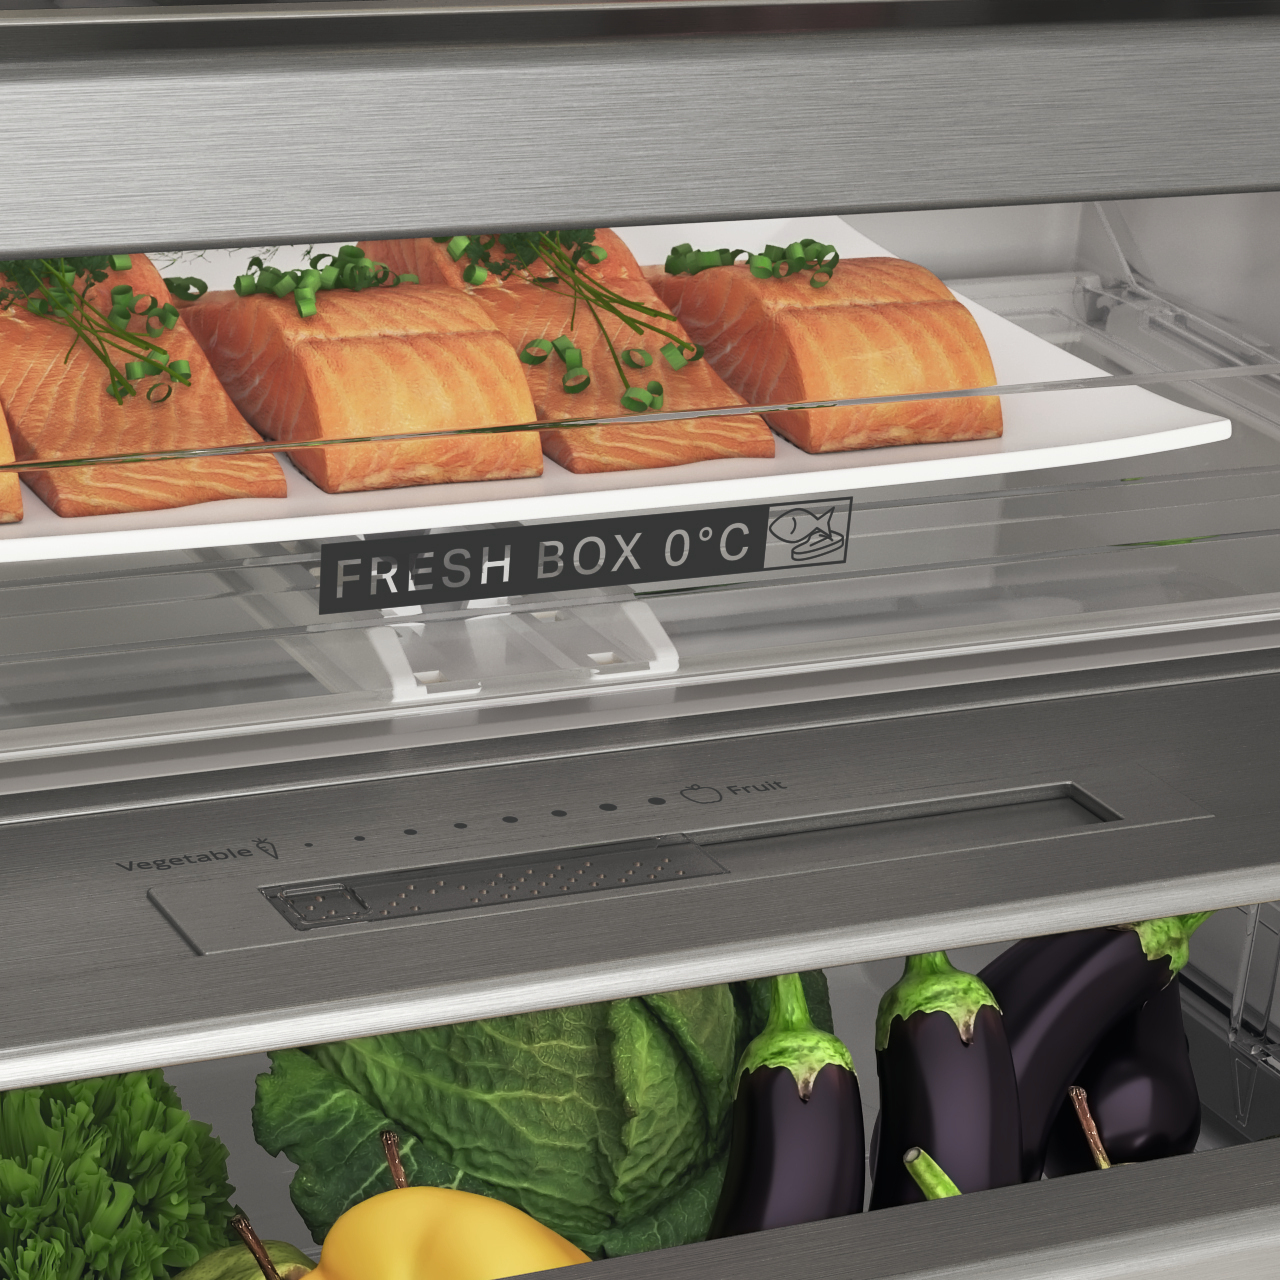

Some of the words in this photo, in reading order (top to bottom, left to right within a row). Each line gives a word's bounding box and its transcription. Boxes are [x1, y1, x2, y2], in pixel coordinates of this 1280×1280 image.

[335, 545, 511, 599] FRESH
[536, 533, 642, 580] BOX
[664, 522, 751, 567] 0°C
[726, 781, 788, 795] Fruit
[115, 848, 254, 872] Vegetable
